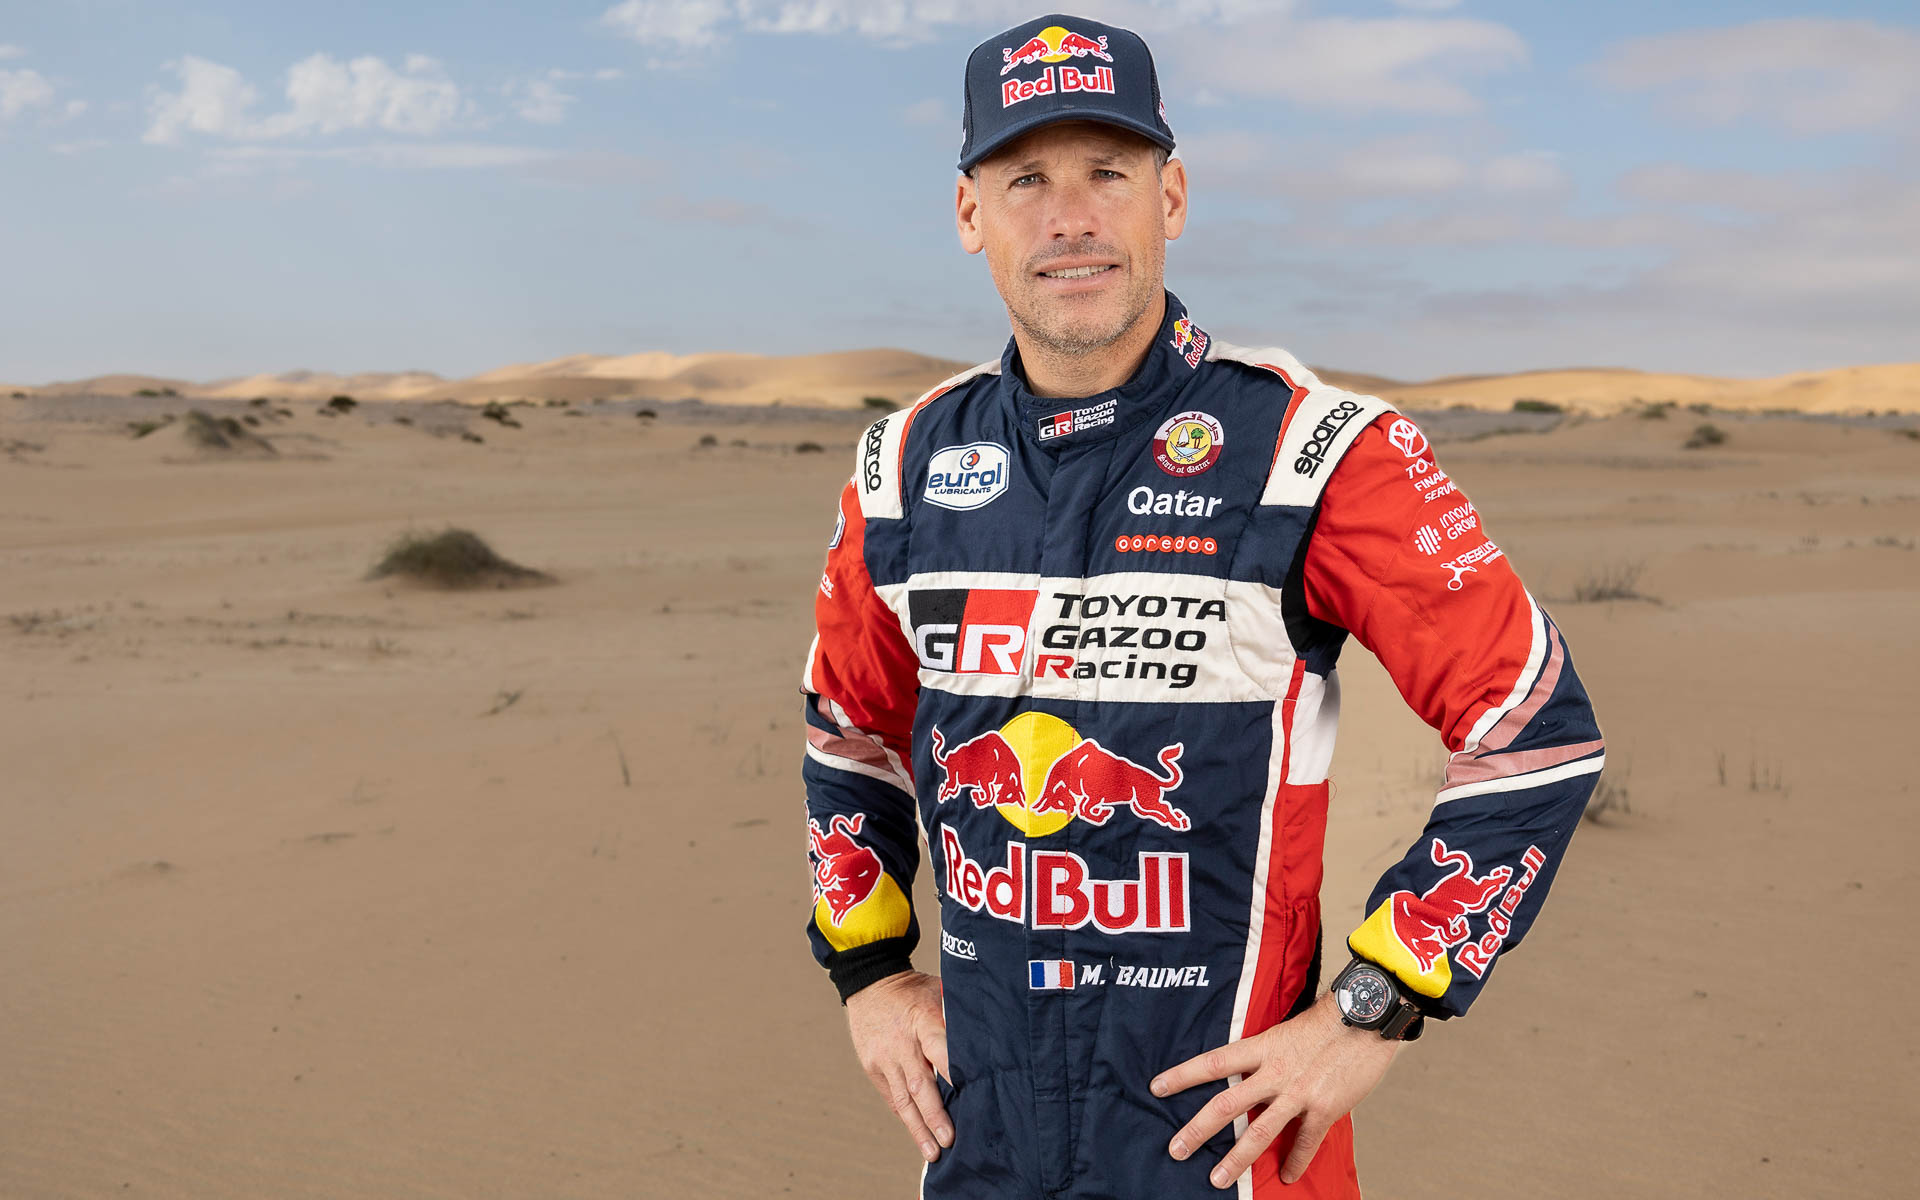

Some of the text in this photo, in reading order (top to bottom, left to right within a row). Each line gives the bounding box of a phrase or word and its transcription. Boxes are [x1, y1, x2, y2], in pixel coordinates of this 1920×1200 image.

[1003, 67, 1114, 108] Red Bull
[1185, 340, 1203, 369] Red
[1074, 399, 1117, 416] TOYOTA
[1074, 408, 1114, 424] GAZOO
[1041, 421, 1071, 438] GR
[1075, 415, 1114, 432] Racing
[1294, 401, 1358, 475] sparco
[867, 419, 889, 491] sparco
[928, 463, 1002, 488] eurol
[935, 487, 991, 495] LUBRICANTS
[1128, 486, 1222, 517] Qatar
[1447, 516, 1477, 540] GROUP
[1117, 536, 1216, 553] ooredoo
[1053, 593, 1226, 621] TOYOTA
[916, 624, 1026, 673] GR
[1042, 625, 1206, 650] GAZOO
[1034, 654, 1198, 688] Racing
[942, 824, 1190, 933] Red Bull
[1456, 845, 1546, 979] Red Bull
[1080, 965, 1210, 987] M. BAUMEL
